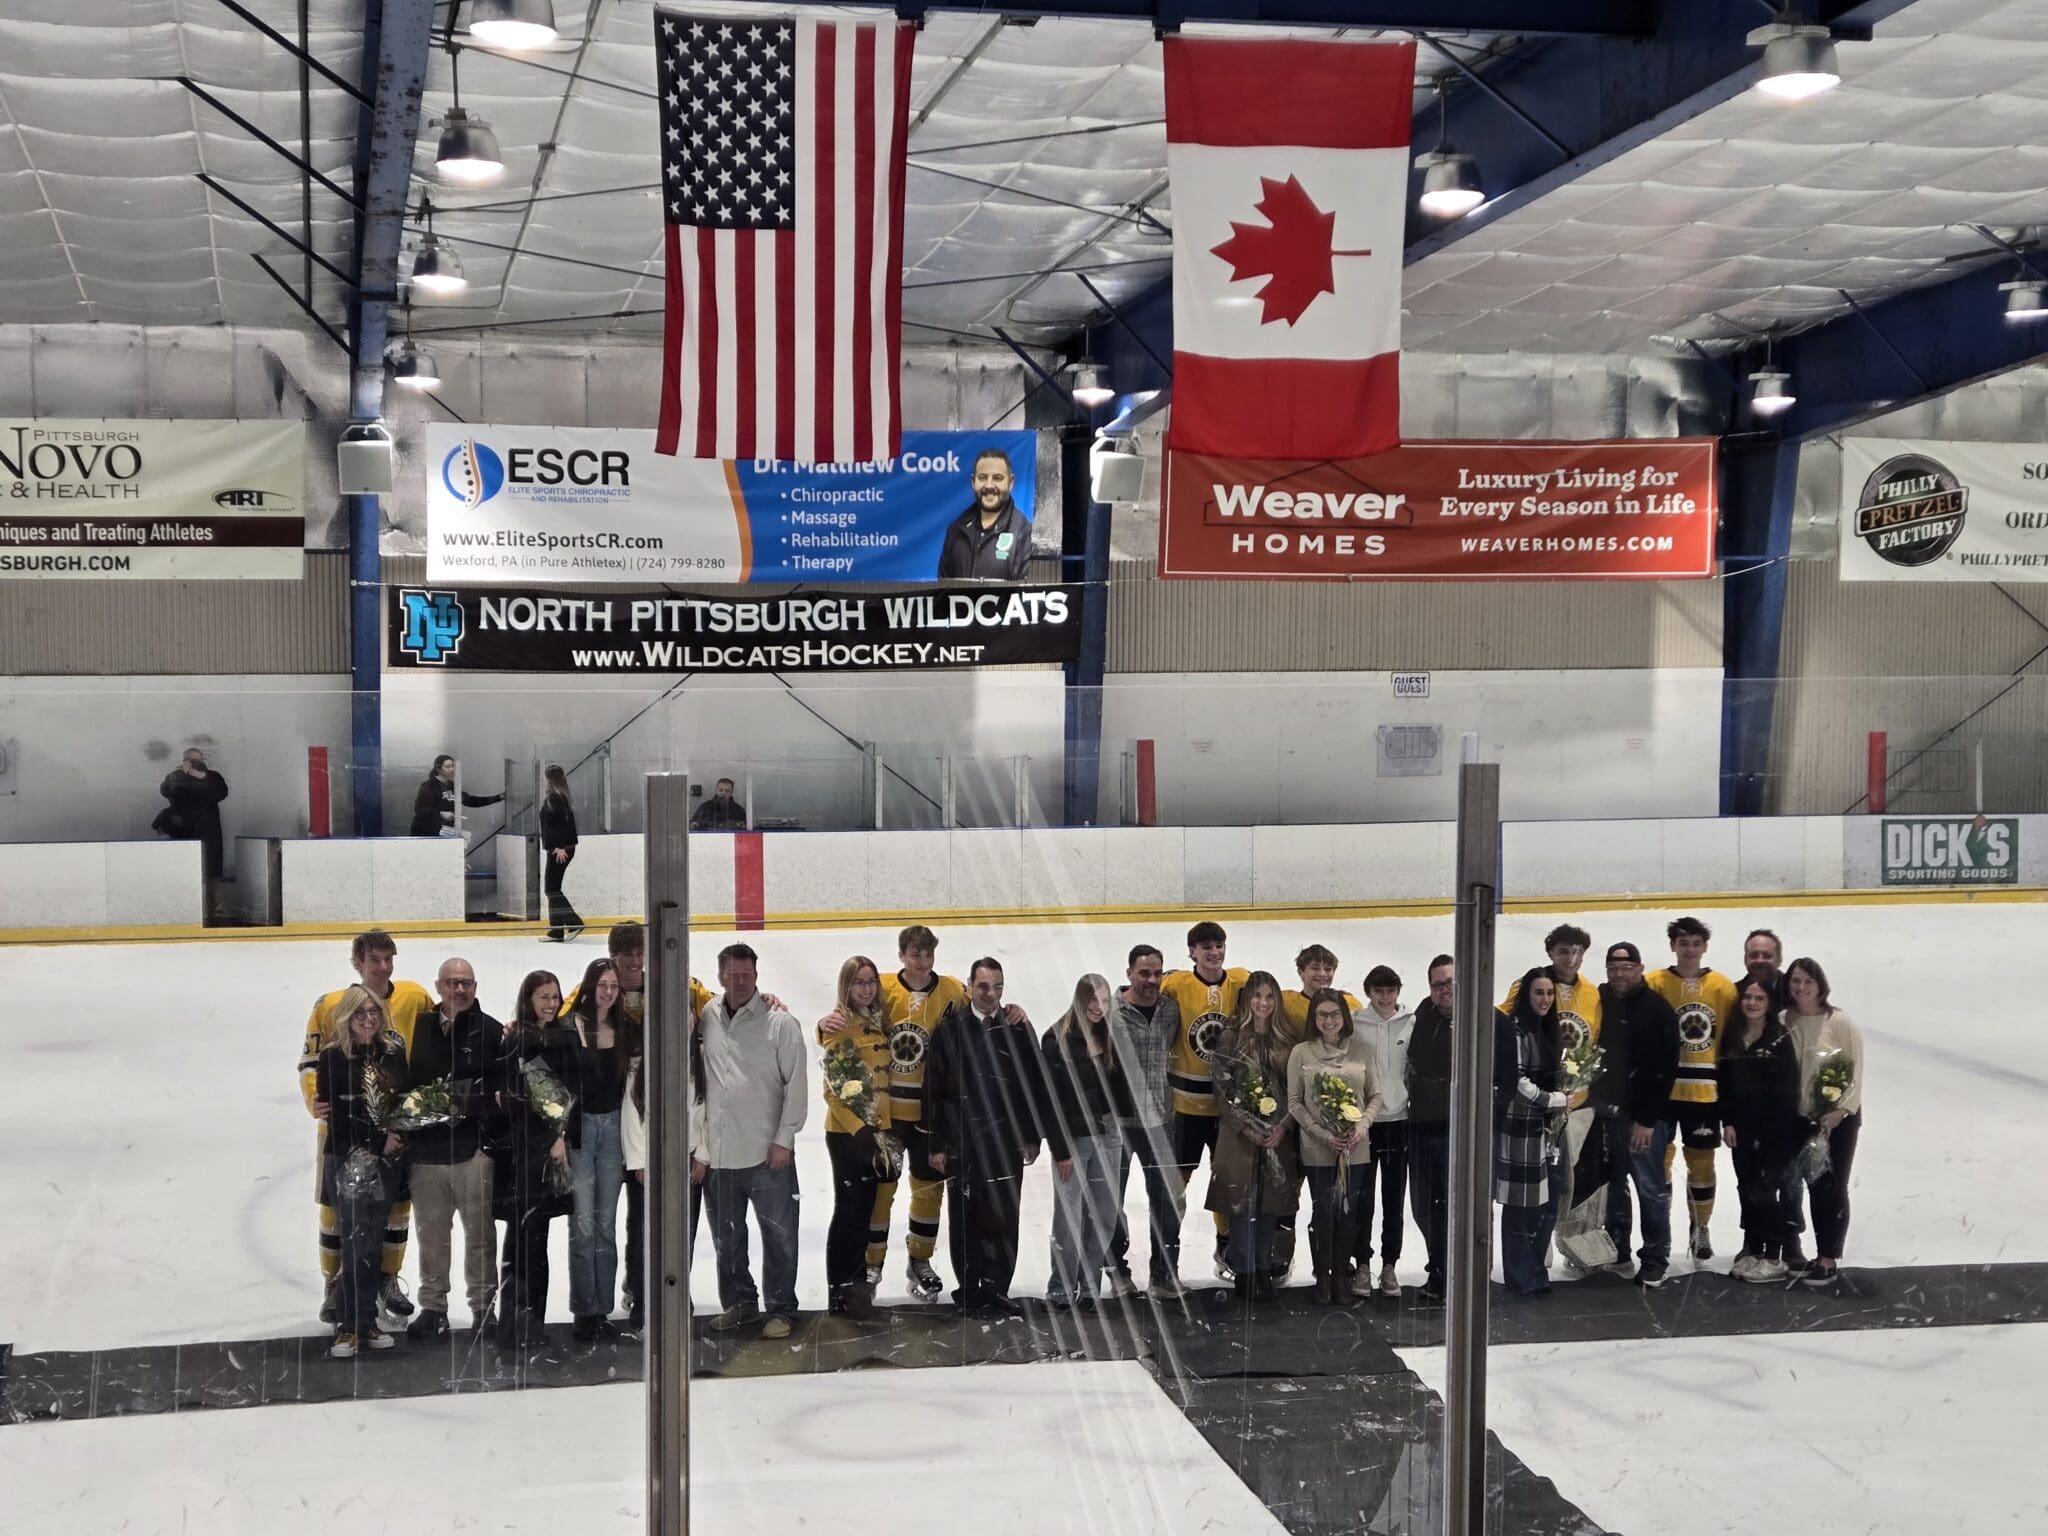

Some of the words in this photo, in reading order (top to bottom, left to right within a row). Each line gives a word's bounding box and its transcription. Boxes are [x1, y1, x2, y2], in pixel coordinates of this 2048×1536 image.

[33, 429, 140, 441] PITTSBURGH
[508, 448, 629, 486] ESCR
[754, 458, 787, 474] Dr.
[901, 451, 961, 474] Cook
[2023, 462, 2048, 480] SO
[10, 481, 29, 498] &
[36, 481, 139, 498] HEALTH
[1458, 469, 1550, 493] Luxury
[1554, 467, 1636, 492] Living
[1640, 466, 1679, 486] for
[1878, 474, 1940, 500] PHILLY
[532, 487, 566, 495] SPORTS
[568, 488, 631, 496] CHIROPRACTIC
[790, 487, 884, 504] Chiropractic
[1213, 484, 1405, 520] Weaver
[1439, 497, 1515, 521] Every
[1520, 496, 1609, 516] Season
[1614, 495, 1641, 514] in
[1646, 493, 1696, 515] Life
[1869, 494, 1958, 528] PRETZEL
[790, 510, 857, 528] Massage
[51, 523, 80, 540] and
[83, 523, 146, 544] Treating
[150, 523, 213, 540] Athletes
[443, 530, 663, 551] www.EliteSportsCR.com
[790, 532, 898, 547] Rehabilitation
[1232, 533, 1386, 555] HOMES
[1461, 536, 1673, 552] WEAVERHOMES.COM
[1878, 519, 1958, 550] FACTORY
[0, 555, 130, 570] SBURGH.COM
[442, 555, 498, 567] Wexford,
[501, 556, 518, 567] PA
[521, 556, 536, 570] (in
[540, 556, 568, 568] Pure
[571, 556, 626, 570] Athletex)
[636, 558, 667, 570] (724)
[670, 558, 725, 569] 799-8280
[791, 555, 854, 572] Therapy
[478, 597, 612, 632] NORTH
[630, 599, 866, 633] PITTSBURGH
[883, 591, 1069, 629] WILDCATS
[1887, 823, 2010, 867] DICK'S
[1888, 868, 1956, 880] SPORTING
[1961, 868, 2008, 879] GOODS
